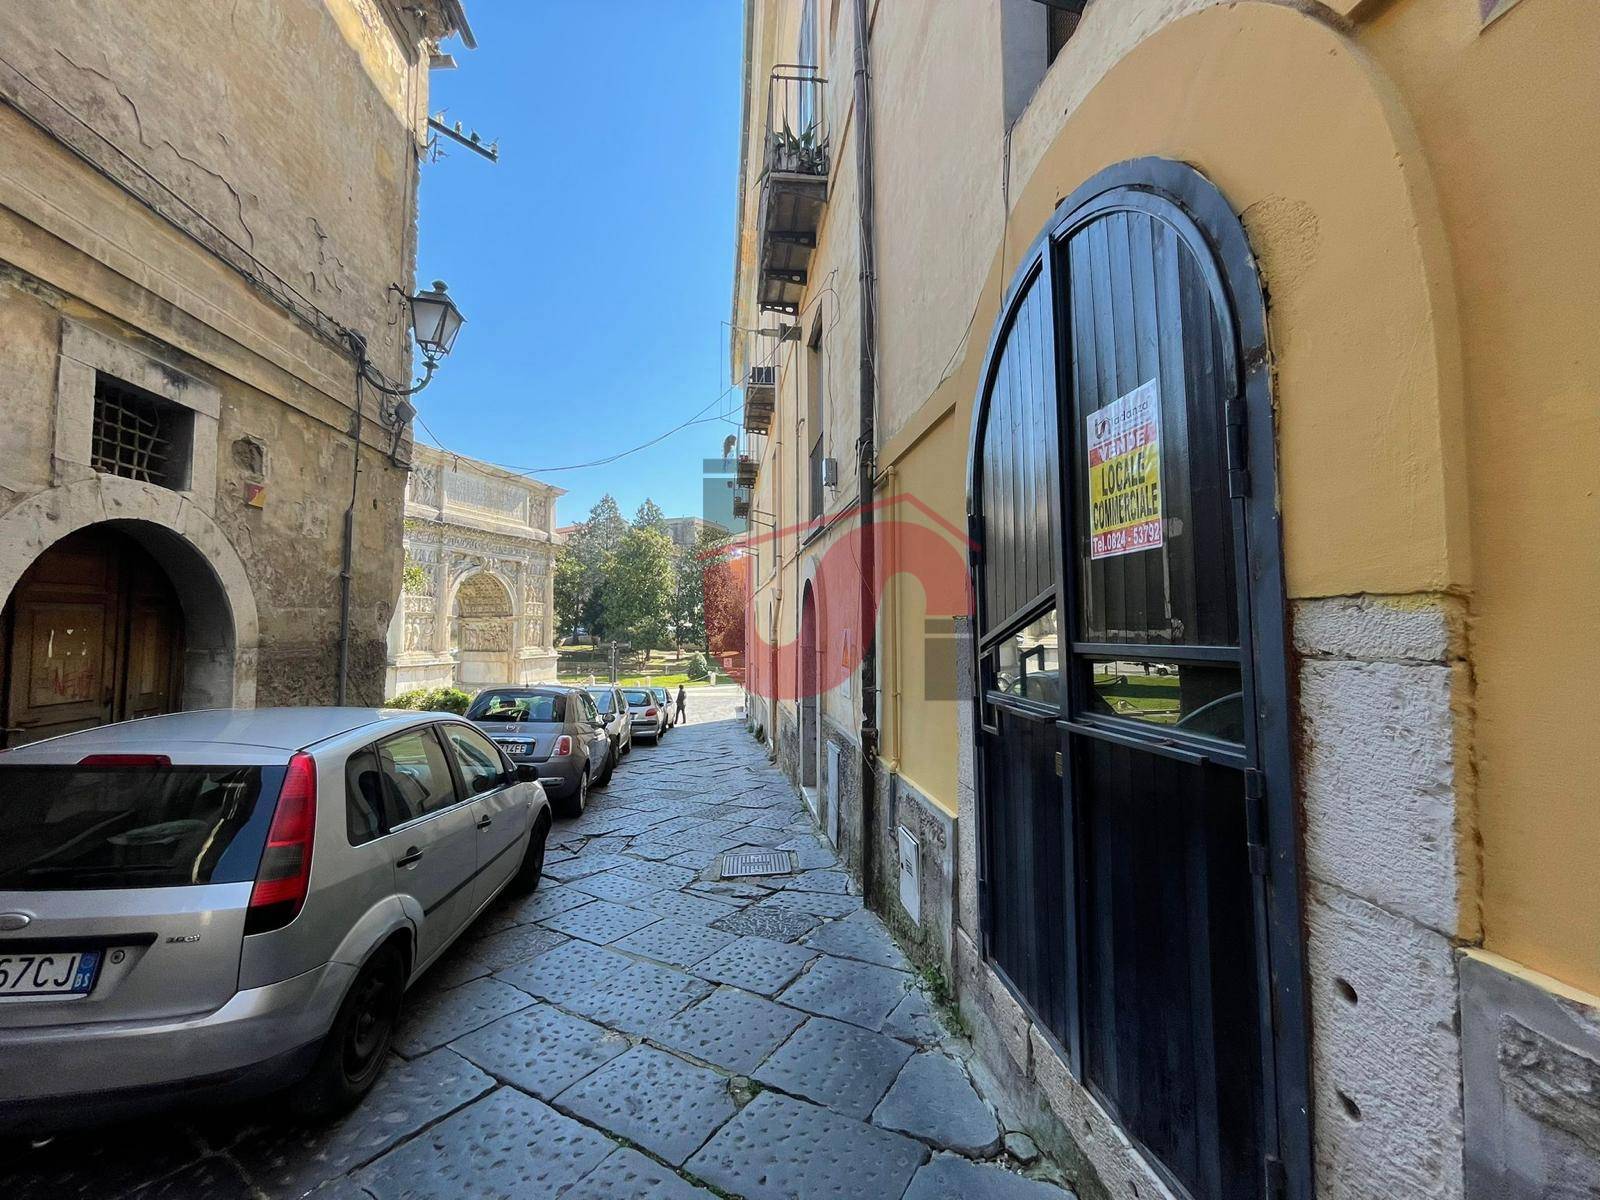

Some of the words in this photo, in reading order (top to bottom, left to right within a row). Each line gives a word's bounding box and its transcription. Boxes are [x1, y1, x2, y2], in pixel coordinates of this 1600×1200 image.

[1098, 426, 1146, 462] VENDE
[1102, 452, 1145, 496] LOCALE
[1093, 483, 1158, 531] COMMERCIALE
[1133, 522, 1160, 544] 53792
[74, 973, 91, 988] BS
